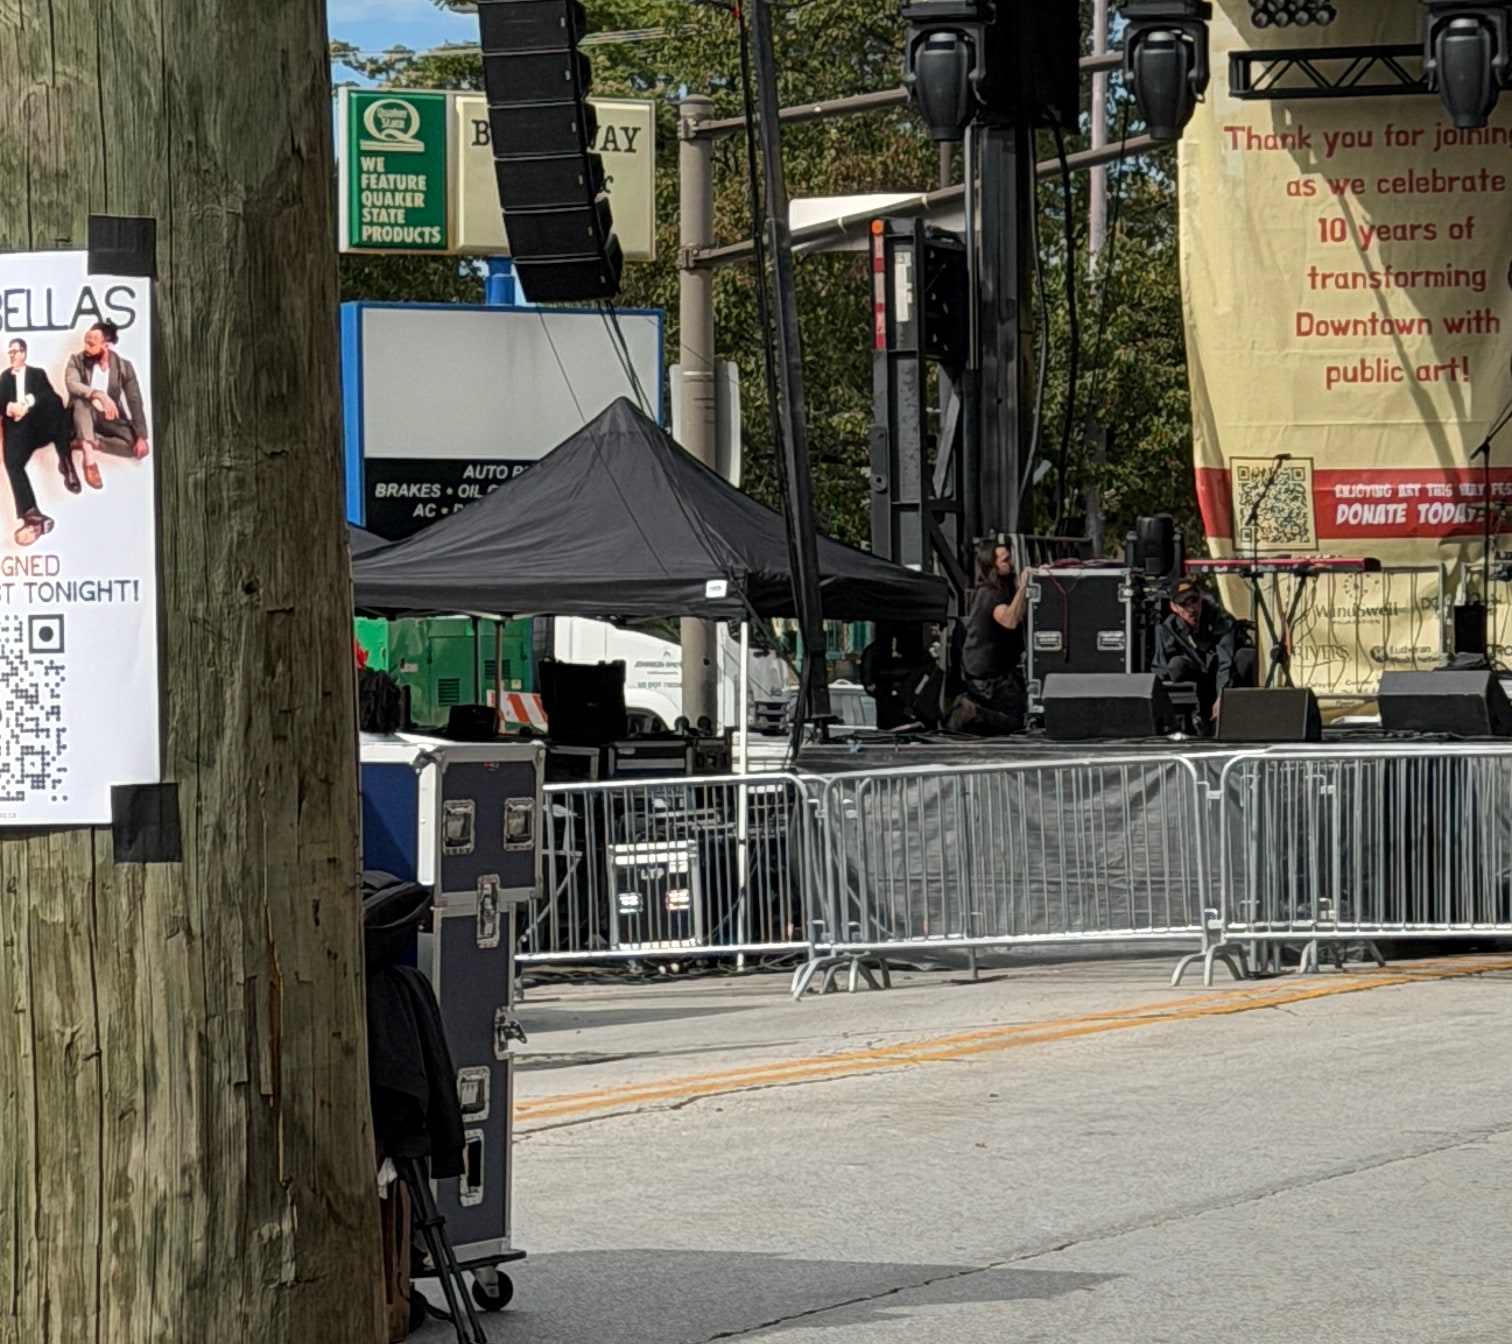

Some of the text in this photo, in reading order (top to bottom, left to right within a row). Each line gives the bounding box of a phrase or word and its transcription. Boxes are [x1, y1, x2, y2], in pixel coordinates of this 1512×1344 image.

[1223, 125, 1313, 151] Thank
[1322, 128, 1373, 158] you
[1384, 123, 1424, 147] for
[360, 156, 385, 172] WE
[361, 173, 427, 191] FEATURE
[1286, 168, 1506, 197] as we celebrate
[361, 190, 425, 208] QUAKER
[361, 207, 406, 224] STATE
[361, 225, 442, 244] PRODUCTS
[1318, 215, 1476, 252] 10 years of
[1307, 264, 1487, 292] transforming
[0, 286, 136, 332] ELLAS
[1296, 308, 1500, 337] Downtown with
[1326, 356, 1470, 390] public art!
[462, 464, 508, 480] AUTO
[374, 482, 442, 498] BRAKES
[457, 484, 483, 498] OIL
[1398, 483, 1421, 498] ART
[1425, 483, 1453, 498] THIS
[412, 503, 437, 518] AC
[1335, 502, 1407, 526] DONATE
[23, 579, 140, 604] TONIGHT!
